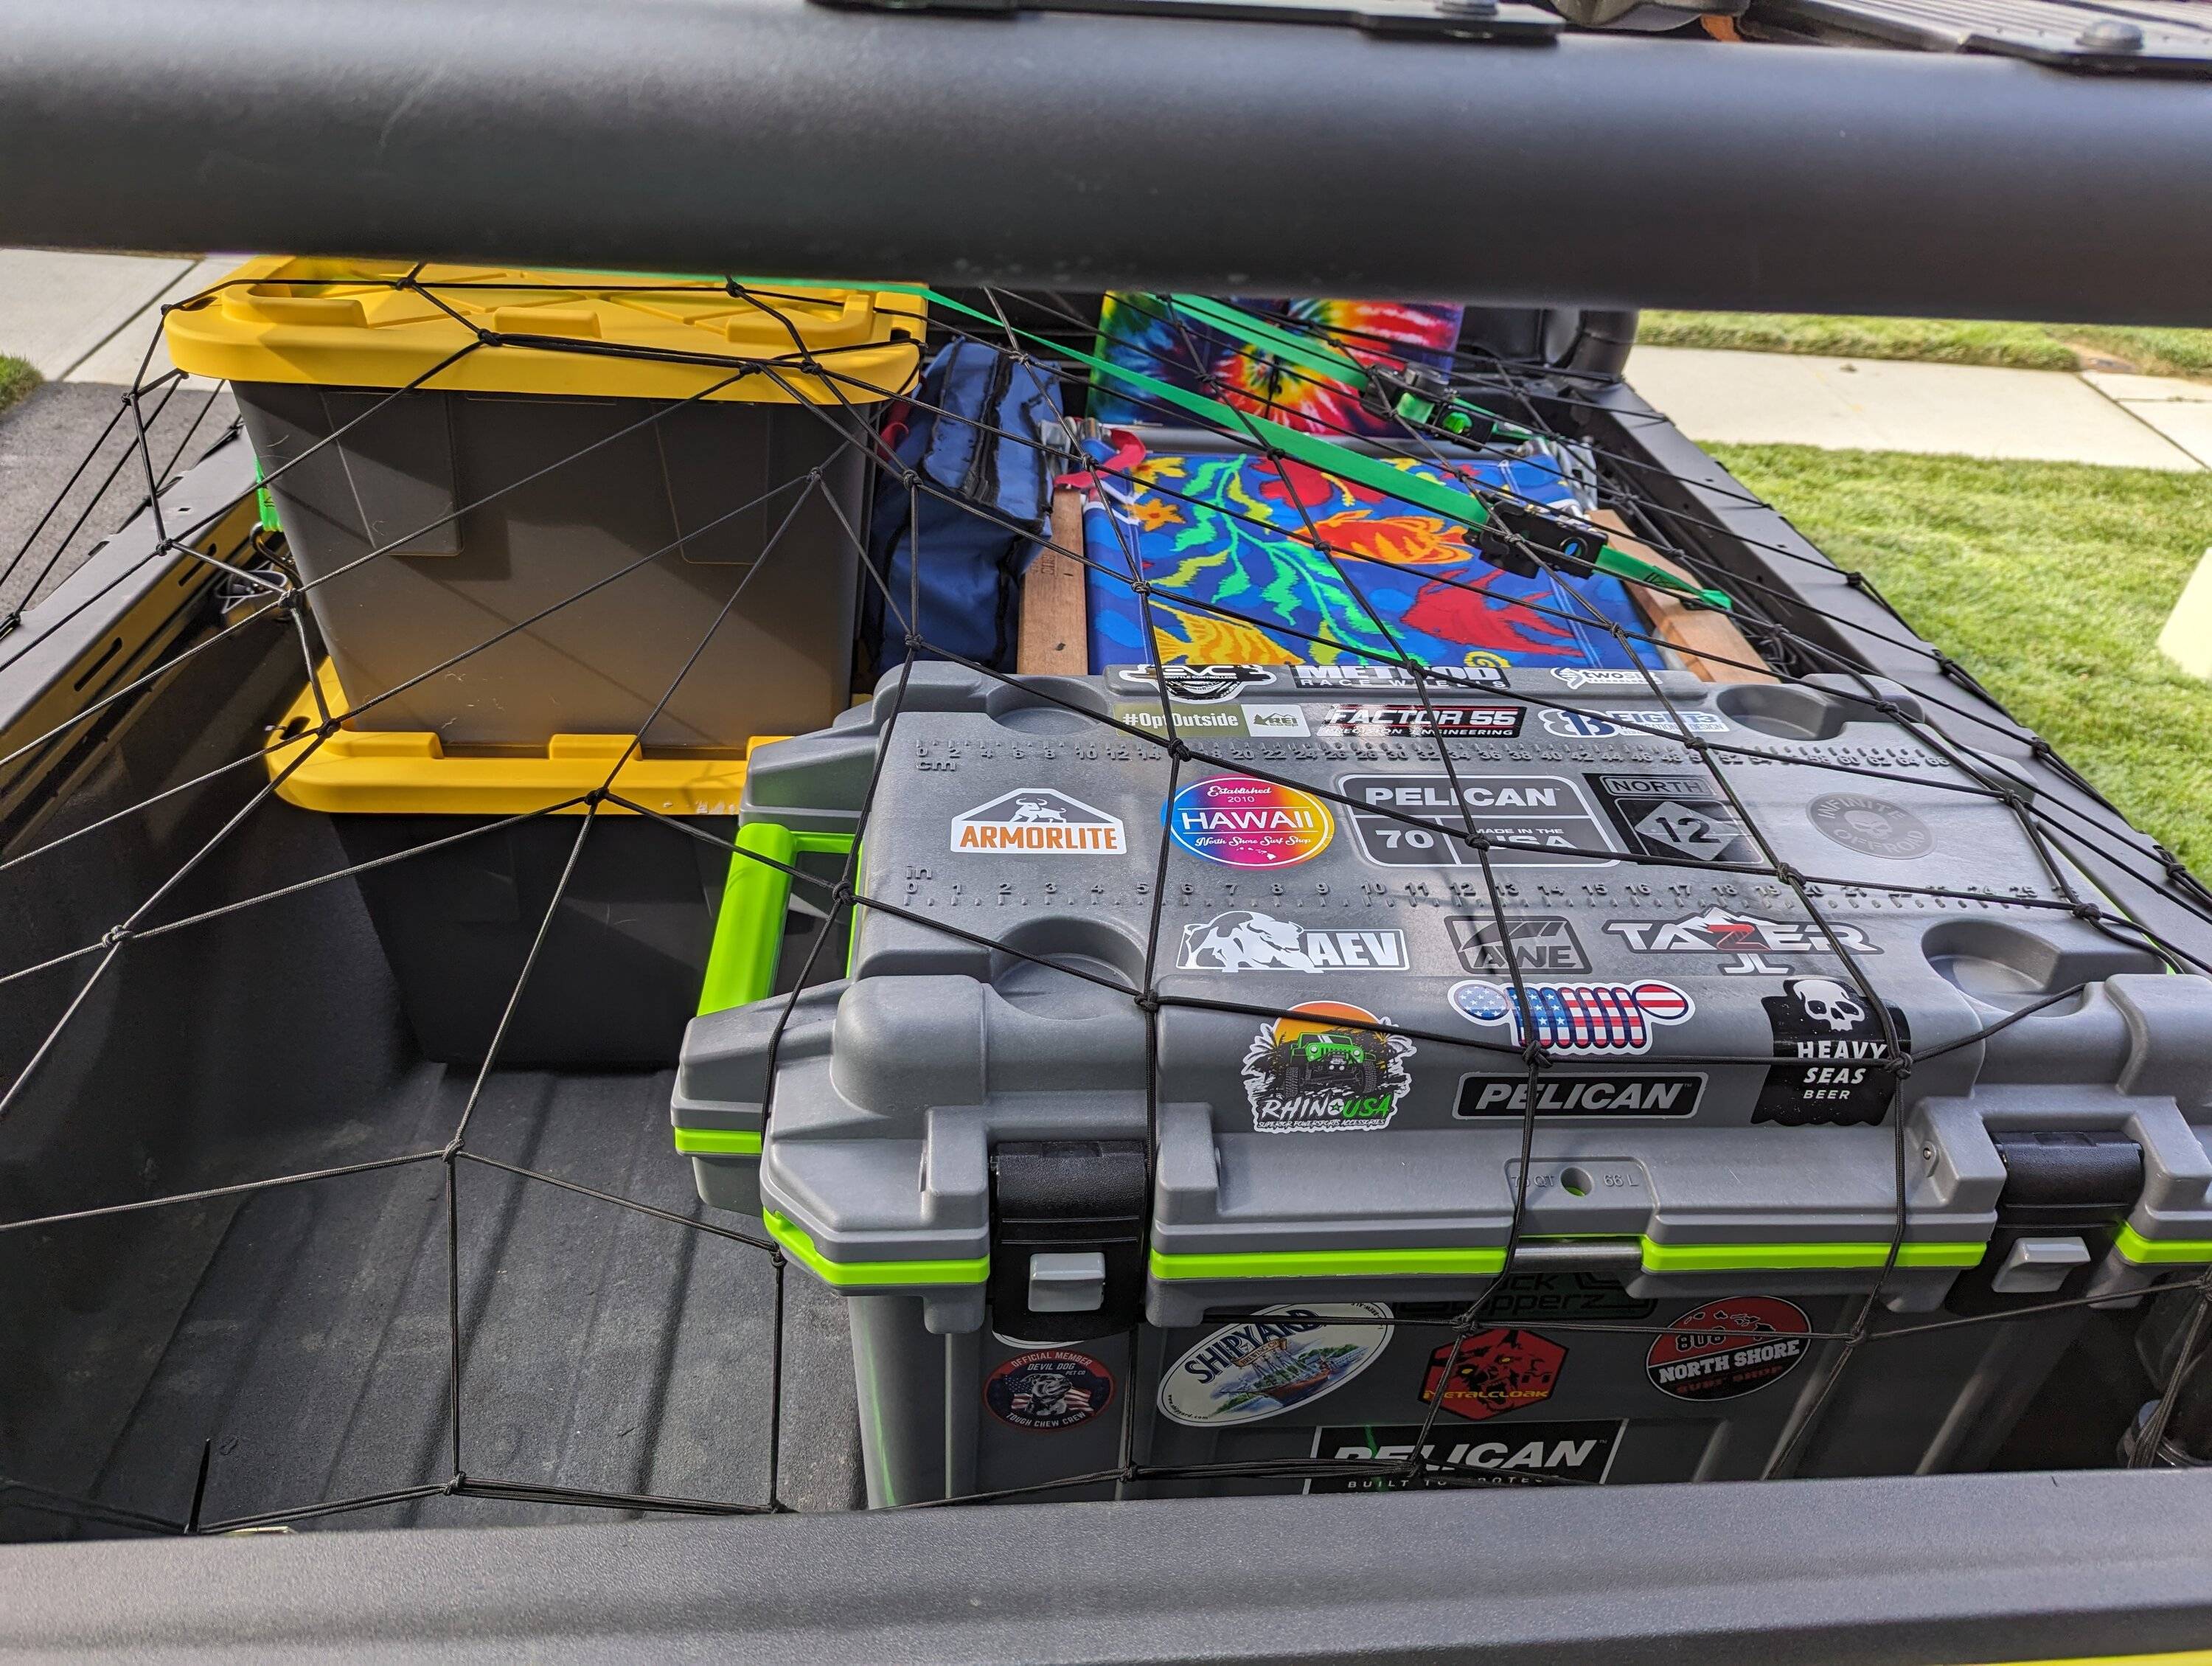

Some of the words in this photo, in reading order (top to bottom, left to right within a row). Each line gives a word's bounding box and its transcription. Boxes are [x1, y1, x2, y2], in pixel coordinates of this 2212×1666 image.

[1295, 665, 1501, 680] METOD
[1329, 709, 1467, 725] FACTOR
[1469, 710, 1517, 725] 55
[916, 747, 928, 757] 0
[950, 747, 960, 757] 2
[981, 748, 993, 758] 4
[1012, 748, 1024, 758] 6
[1044, 748, 1057, 759] 8
[1076, 748, 1098, 760] 10
[1107, 749, 1130, 760] 12
[1138, 749, 1161, 760] 14
[1232, 749, 1254, 760] 20
[1263, 749, 1287, 760] 22
[1295, 749, 1318, 760] 24
[1326, 749, 1348, 760] 26
[1356, 749, 1378, 760] 28
[1386, 749, 1408, 761] 30
[1417, 749, 1441, 761] 32
[1449, 750, 1472, 761] 34
[1480, 751, 1502, 761] 36
[1510, 751, 1532, 761] 38
[1540, 751, 1562, 761] 40
[1571, 751, 1595, 762] 42
[1601, 751, 1624, 762] 44
[1631, 752, 1653, 763] 46
[1660, 752, 1683, 763] 48
[1719, 754, 1743, 765] 52
[1837, 756, 1860, 766] 60
[1867, 756, 1891, 767] 62
[1896, 757, 1920, 767] 64
[1925, 757, 1950, 768] 66
[916, 760, 957, 771] cm
[1207, 785, 1272, 796] Established
[1611, 780, 1704, 793] NORTH
[1365, 787, 1557, 807] PELICAN
[1817, 797, 1907, 820] INFINITE
[1181, 811, 1314, 830] HAWAII
[959, 825, 1118, 849] ARMORLITE
[1655, 816, 1722, 844] 12
[1194, 837, 1227, 847] North
[1228, 836, 1258, 846] Shore
[1260, 836, 1284, 846] Surf
[1285, 836, 1313, 846] Shop
[1376, 830, 1434, 849] 70
[906, 865, 932, 880] in
[905, 883, 917, 894] 0
[953, 884, 962, 894] 1
[999, 883, 1012, 895] 2
[1045, 883, 1057, 894] 3
[1091, 883, 1104, 894] 4
[1136, 883, 1149, 894] 5
[1180, 883, 1194, 895] 6
[1225, 884, 1239, 895] 7
[1270, 883, 1284, 895] 8
[1315, 883, 1329, 895] 9
[1360, 883, 1385, 895] 10
[1404, 882, 1429, 895] 11
[1450, 882, 1477, 896] 12
[1495, 882, 1519, 896] 13
[1537, 883, 1565, 895] 14
[1581, 882, 1607, 895] 15
[1625, 883, 1651, 895] 16
[1668, 883, 1692, 895] 17
[1711, 883, 1737, 895] 18
[1756, 885, 1781, 896] 19
[2009, 886, 2038, 898] 25
[1607, 921, 1877, 951] TAZER
[1306, 932, 1400, 966] AEV
[1723, 953, 1789, 973] JL
[1797, 1040, 1888, 1059] HEAVY
[1803, 1067, 1867, 1084] SEAS
[1475, 1083, 1687, 1110] PELICAN
[1803, 1089, 1851, 1100] BEER
[1258, 1120, 1293, 1129] SUPERIOR
[1293, 1119, 1341, 1128] POWERSPORTS
[1340, 1118, 1386, 1126] ACCESSORIES
[1533, 1175, 1554, 1187] QT
[1603, 1174, 1624, 1187] 66
[1626, 1174, 1638, 1187] L
[1184, 1309, 1327, 1384] SHIPYARD
[1011, 1352, 1052, 1368] OFFICIAL
[1055, 1352, 1093, 1367] MEMBER
[1239, 1345, 1269, 1365] BREWING
[1660, 1355, 1731, 1384] NORTH
[1733, 1339, 1801, 1367] SHORE
[1026, 1363, 1054, 1371] DEVIL
[1056, 1362, 1076, 1370] DOG
[1005, 1412, 1032, 1426] TOUGH
[1034, 1420, 1060, 1428] CHEW
[1062, 1412, 1087, 1425] CREW
[1348, 1479, 1410, 1488] BUILT
